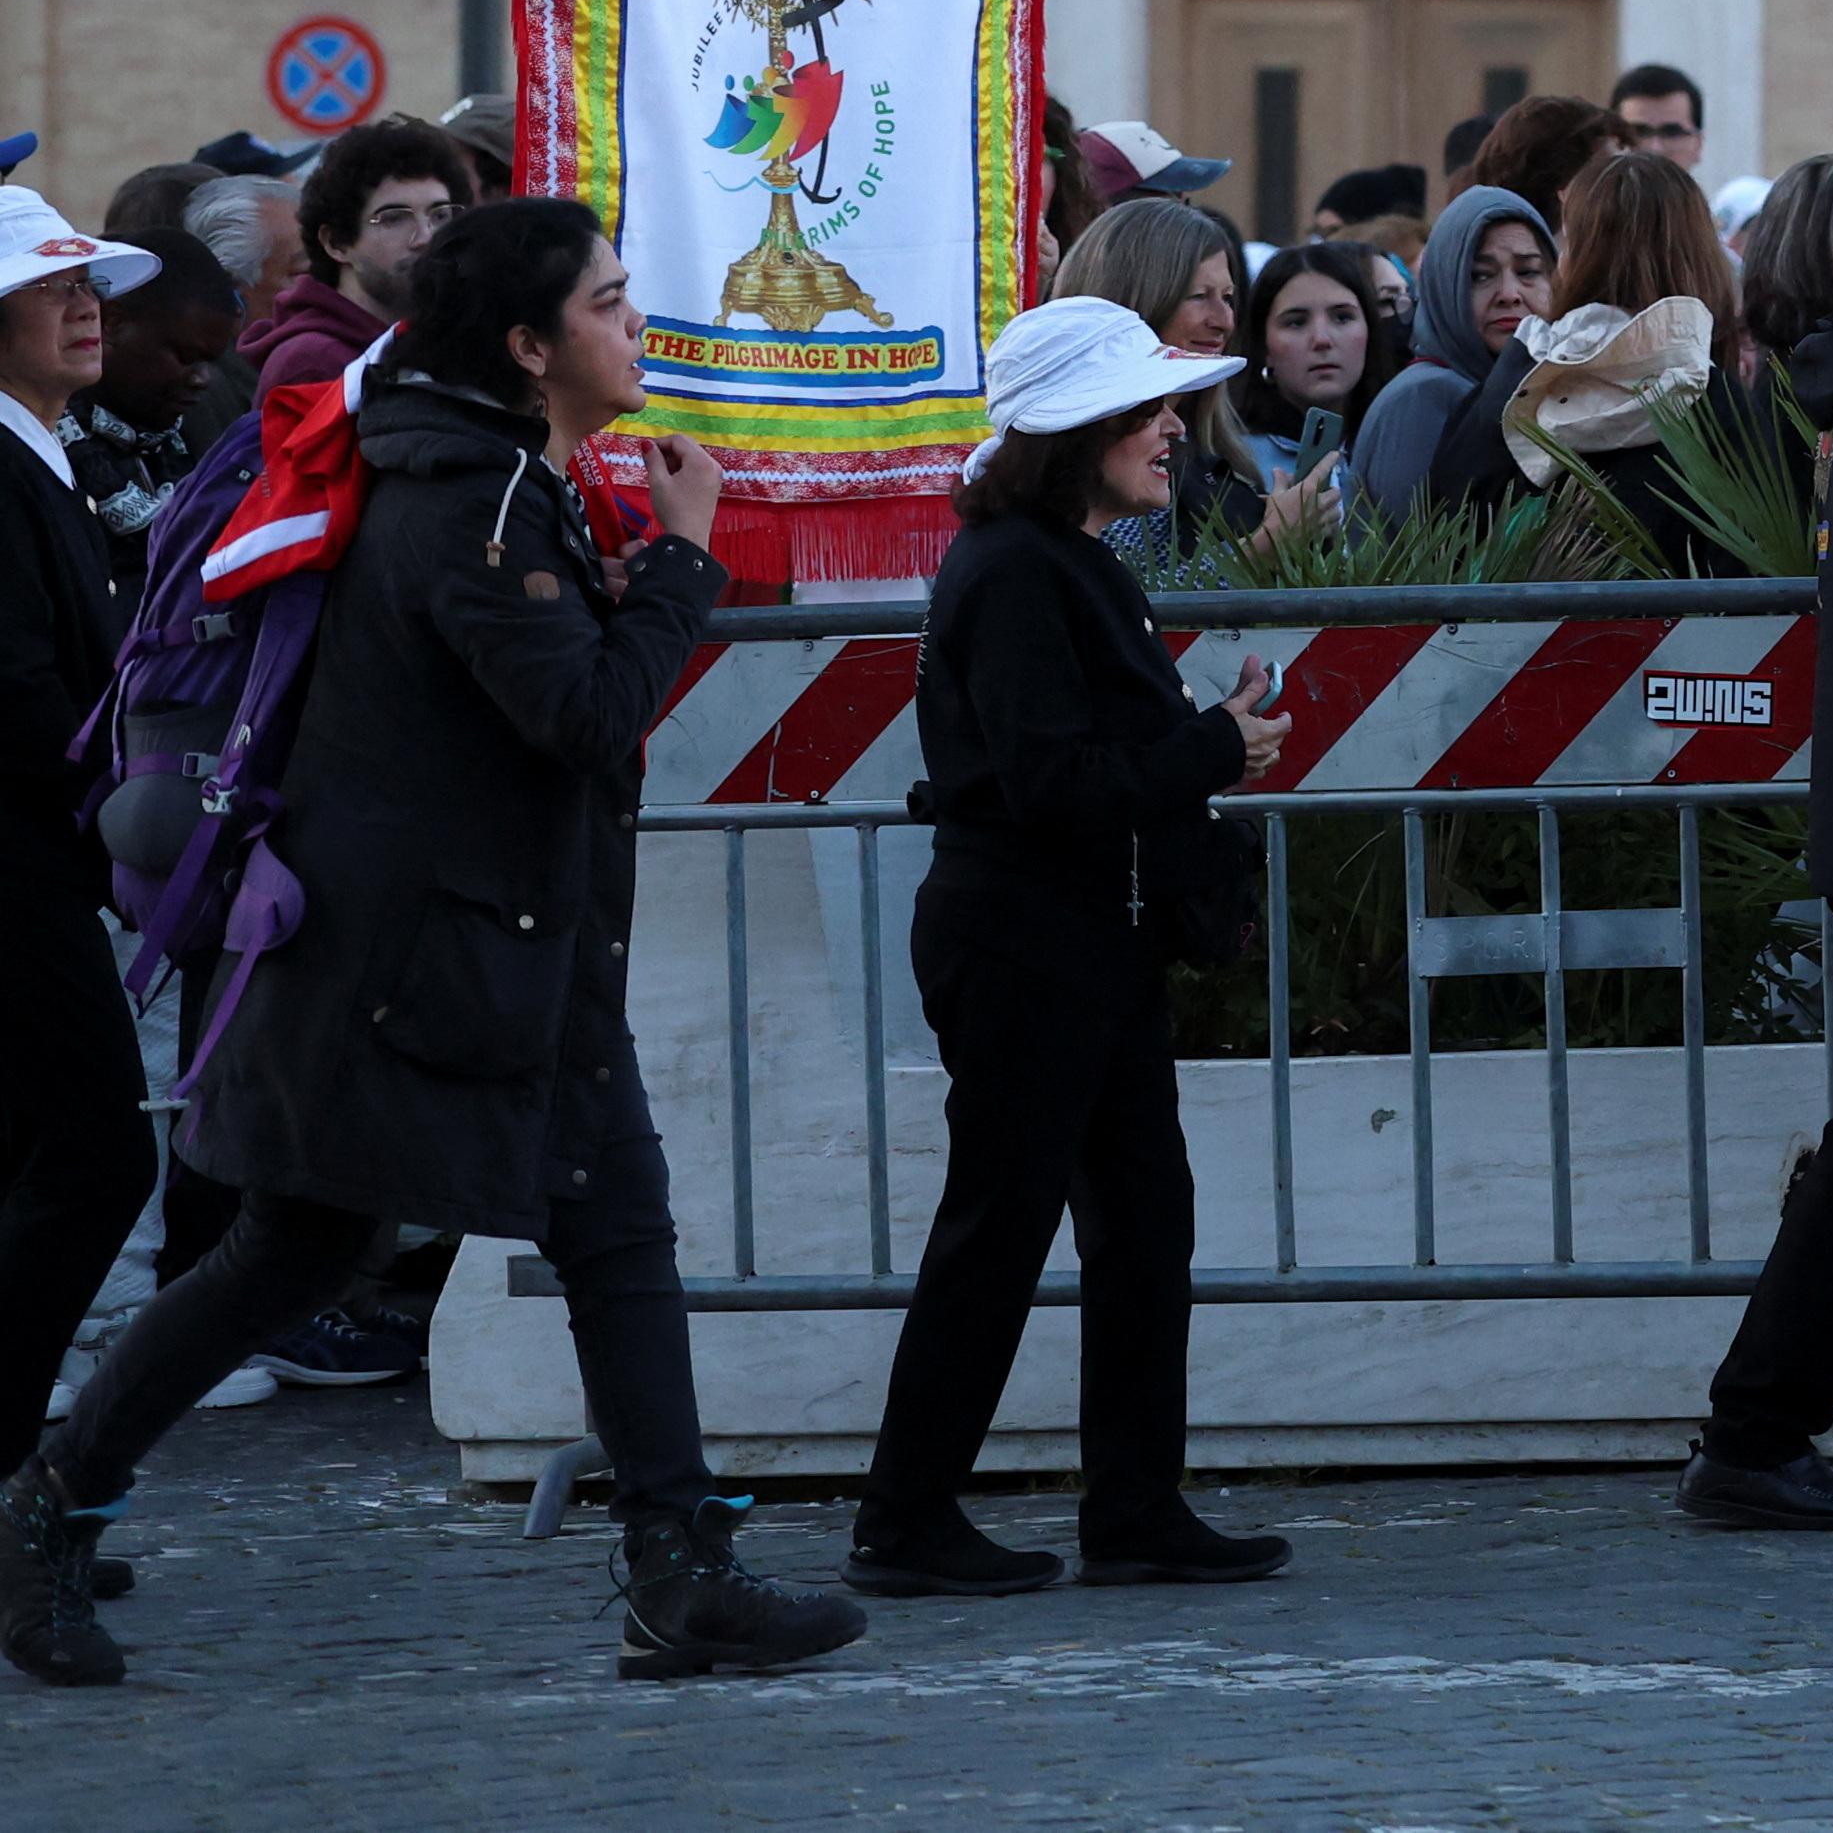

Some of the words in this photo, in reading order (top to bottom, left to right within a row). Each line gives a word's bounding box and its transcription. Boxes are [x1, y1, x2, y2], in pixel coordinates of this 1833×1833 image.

[691, 11, 723, 92] JUBILEE
[869, 80, 896, 157] HOPE
[858, 162, 885, 198] OF
[759, 199, 861, 252] PILGRIMS
[645, 332, 705, 362] THE
[711, 342, 840, 370] PILGRIMAGE
[845, 347, 881, 370] IN
[888, 342, 935, 370] HOPE
[1432, 929, 1535, 964] SPQR
